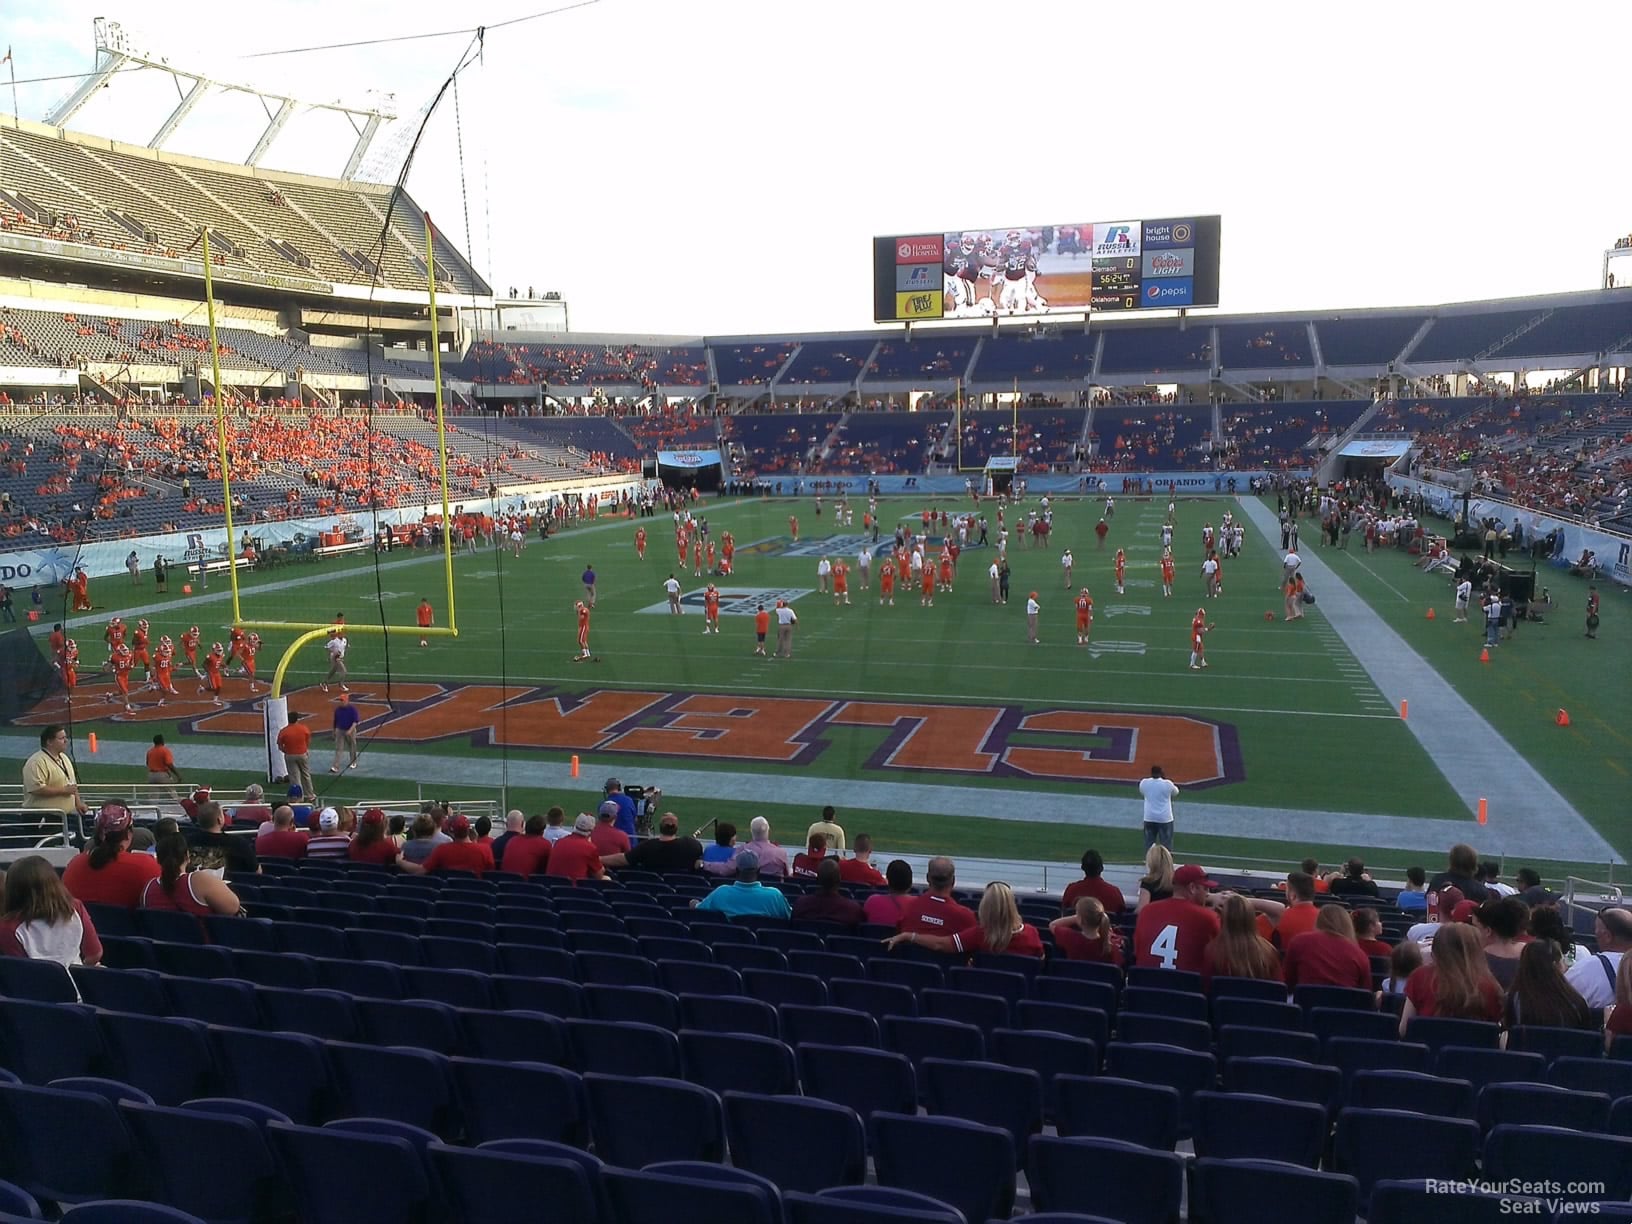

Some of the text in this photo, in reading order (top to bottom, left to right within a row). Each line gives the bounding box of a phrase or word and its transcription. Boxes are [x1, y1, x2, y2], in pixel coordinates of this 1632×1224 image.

[1146, 226, 1170, 234] bright
[1152, 256, 1184, 268] Coors
[1162, 286, 1186, 297] pepsi
[0, 564, 31, 580] DO
[1150, 924, 1178, 969] 4
